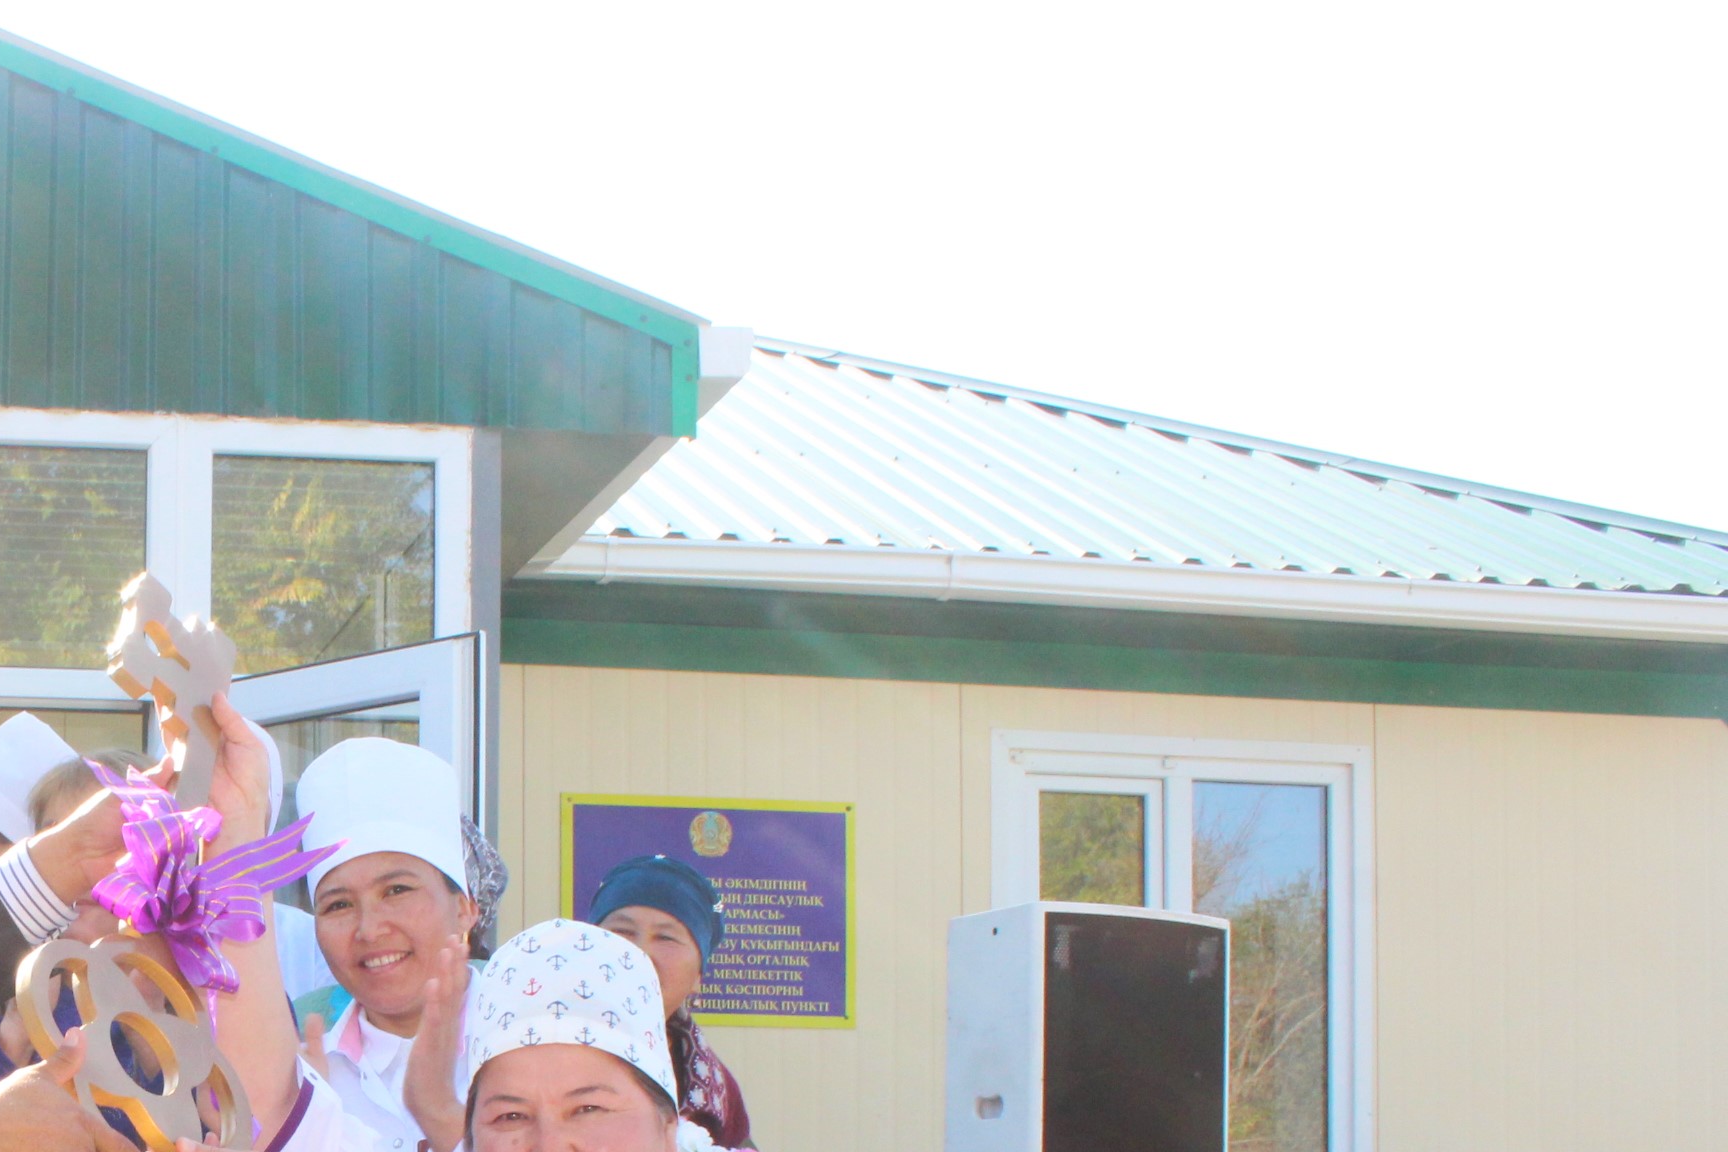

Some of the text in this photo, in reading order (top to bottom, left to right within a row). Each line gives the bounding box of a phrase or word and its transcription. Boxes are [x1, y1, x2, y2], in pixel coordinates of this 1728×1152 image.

[743, 893, 824, 907] ДЕНСАУЛЫҚ
[724, 908, 785, 920] АРМАСЫ»
[724, 923, 801, 936] ЕКЕМЕСІНІҢ
[747, 954, 810, 967] ОРТАЛЫҚ
[714, 969, 803, 981] МЕМЛЕКЕТТІК
[781, 1000, 830, 1013] ПУНКТІ
